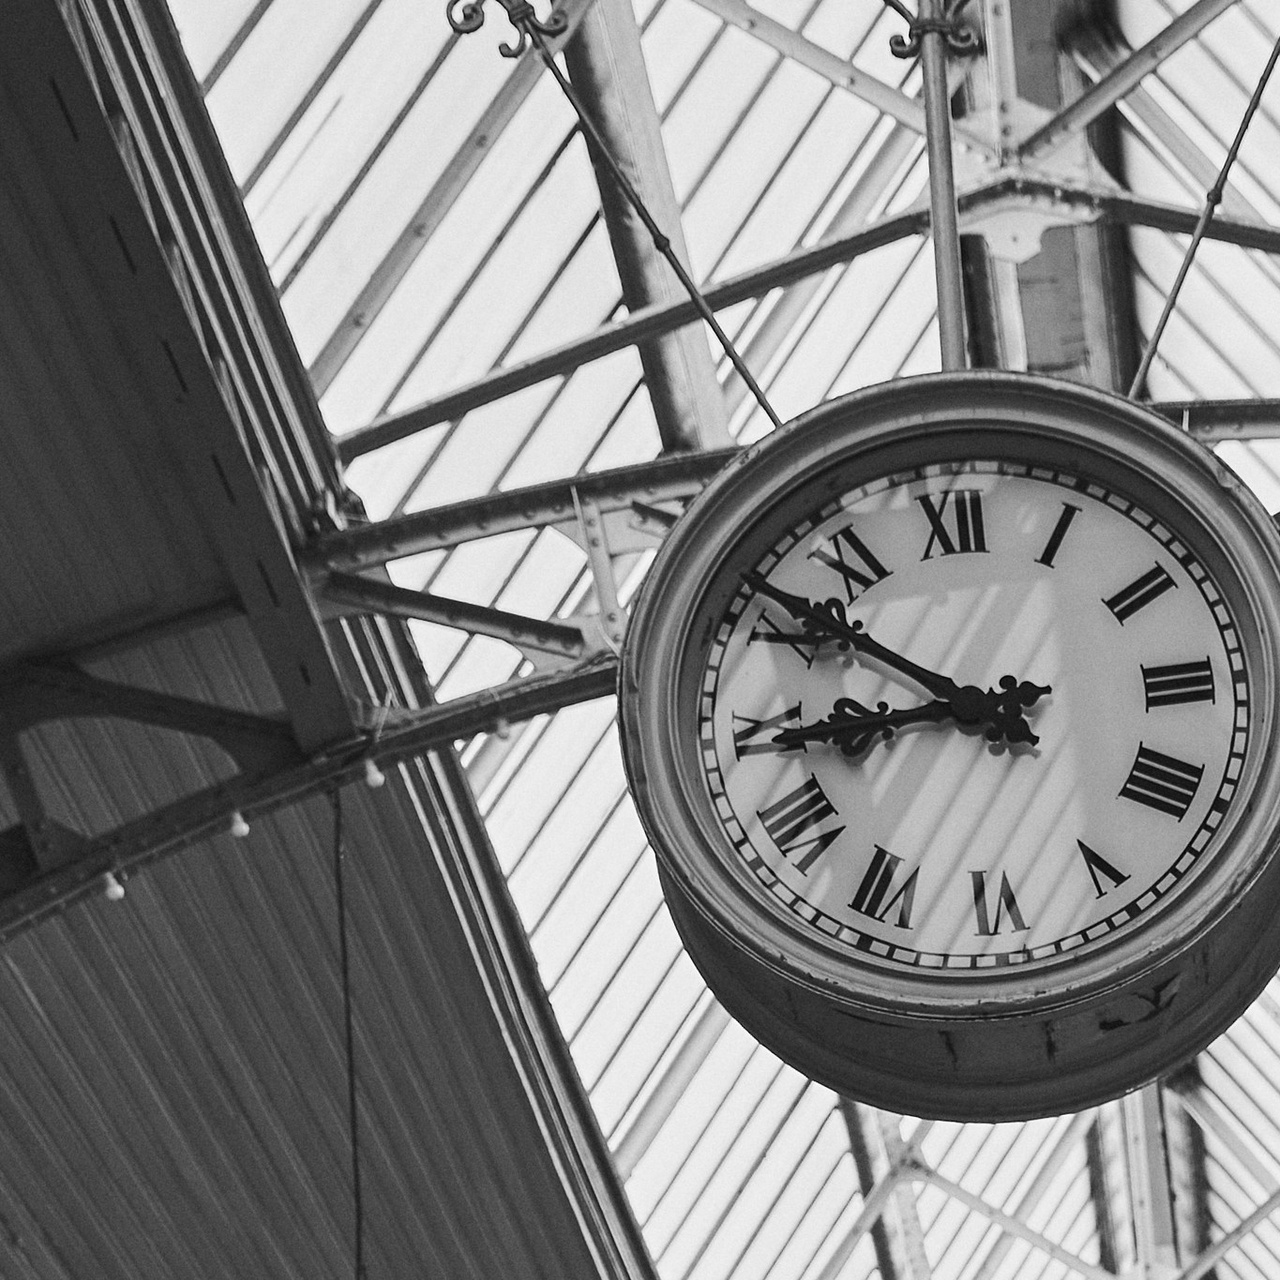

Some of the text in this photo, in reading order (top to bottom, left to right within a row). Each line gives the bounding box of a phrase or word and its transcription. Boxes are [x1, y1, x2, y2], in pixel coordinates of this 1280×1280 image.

[915, 489, 990, 562] XII
[1034, 502, 1083, 568] I
[807, 523, 894, 606] XI
[1101, 561, 1179, 626] II
[747, 609, 822, 669] X
[1140, 655, 1217, 712] III
[732, 701, 807, 761] IX
[1118, 742, 1206, 822] IIII
[757, 773, 847, 875] VIII
[847, 843, 921, 930] VII
[1076, 838, 1132, 899] V
[968, 869, 1031, 937] VI
